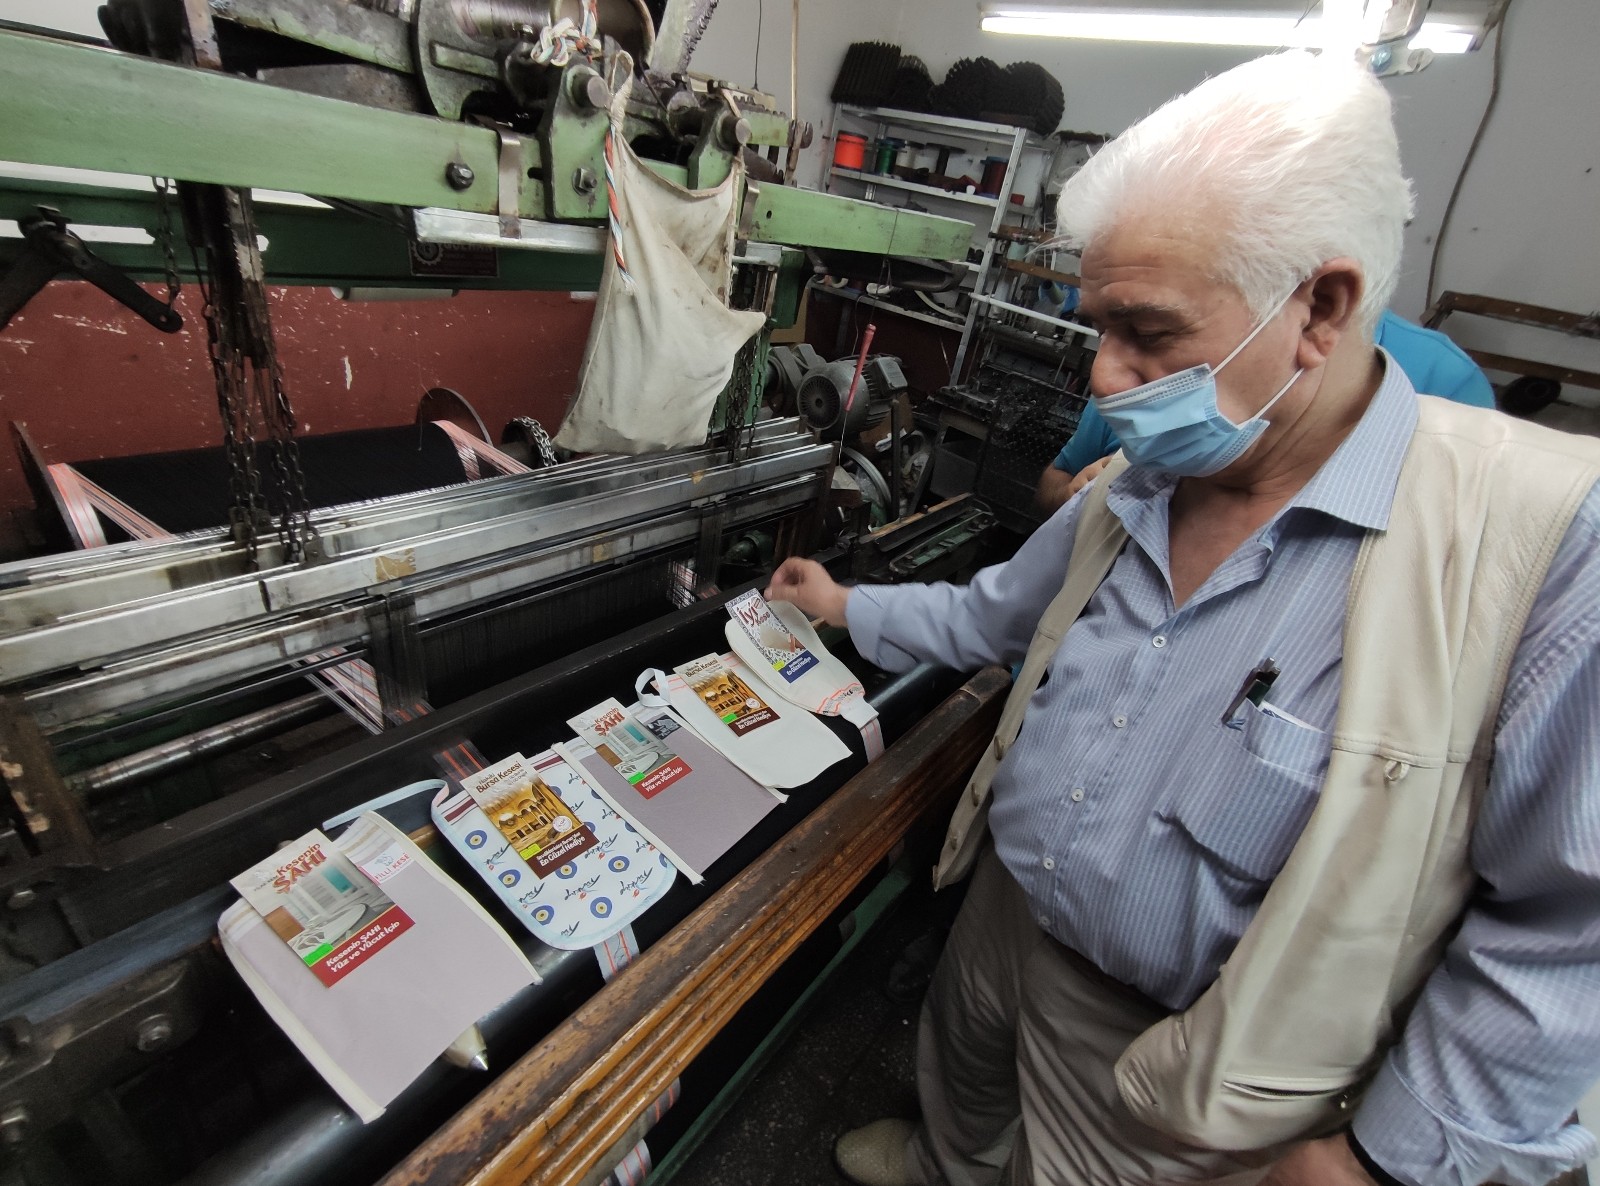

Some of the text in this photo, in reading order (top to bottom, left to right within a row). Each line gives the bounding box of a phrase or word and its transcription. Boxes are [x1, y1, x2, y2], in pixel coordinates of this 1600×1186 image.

[595, 707, 619, 724] Kesenin
[476, 777, 499, 793] Bursa
[499, 761, 522, 779] Kesesi
[276, 843, 321, 876] Kesenin
[548, 846, 566, 861] Güzel
[564, 836, 586, 852] Hediye
[272, 850, 327, 894] ŞAHI
[326, 925, 382, 967] Kesenin ŞAHI
[331, 920, 400, 973] Yüz ve Vücut İçin
